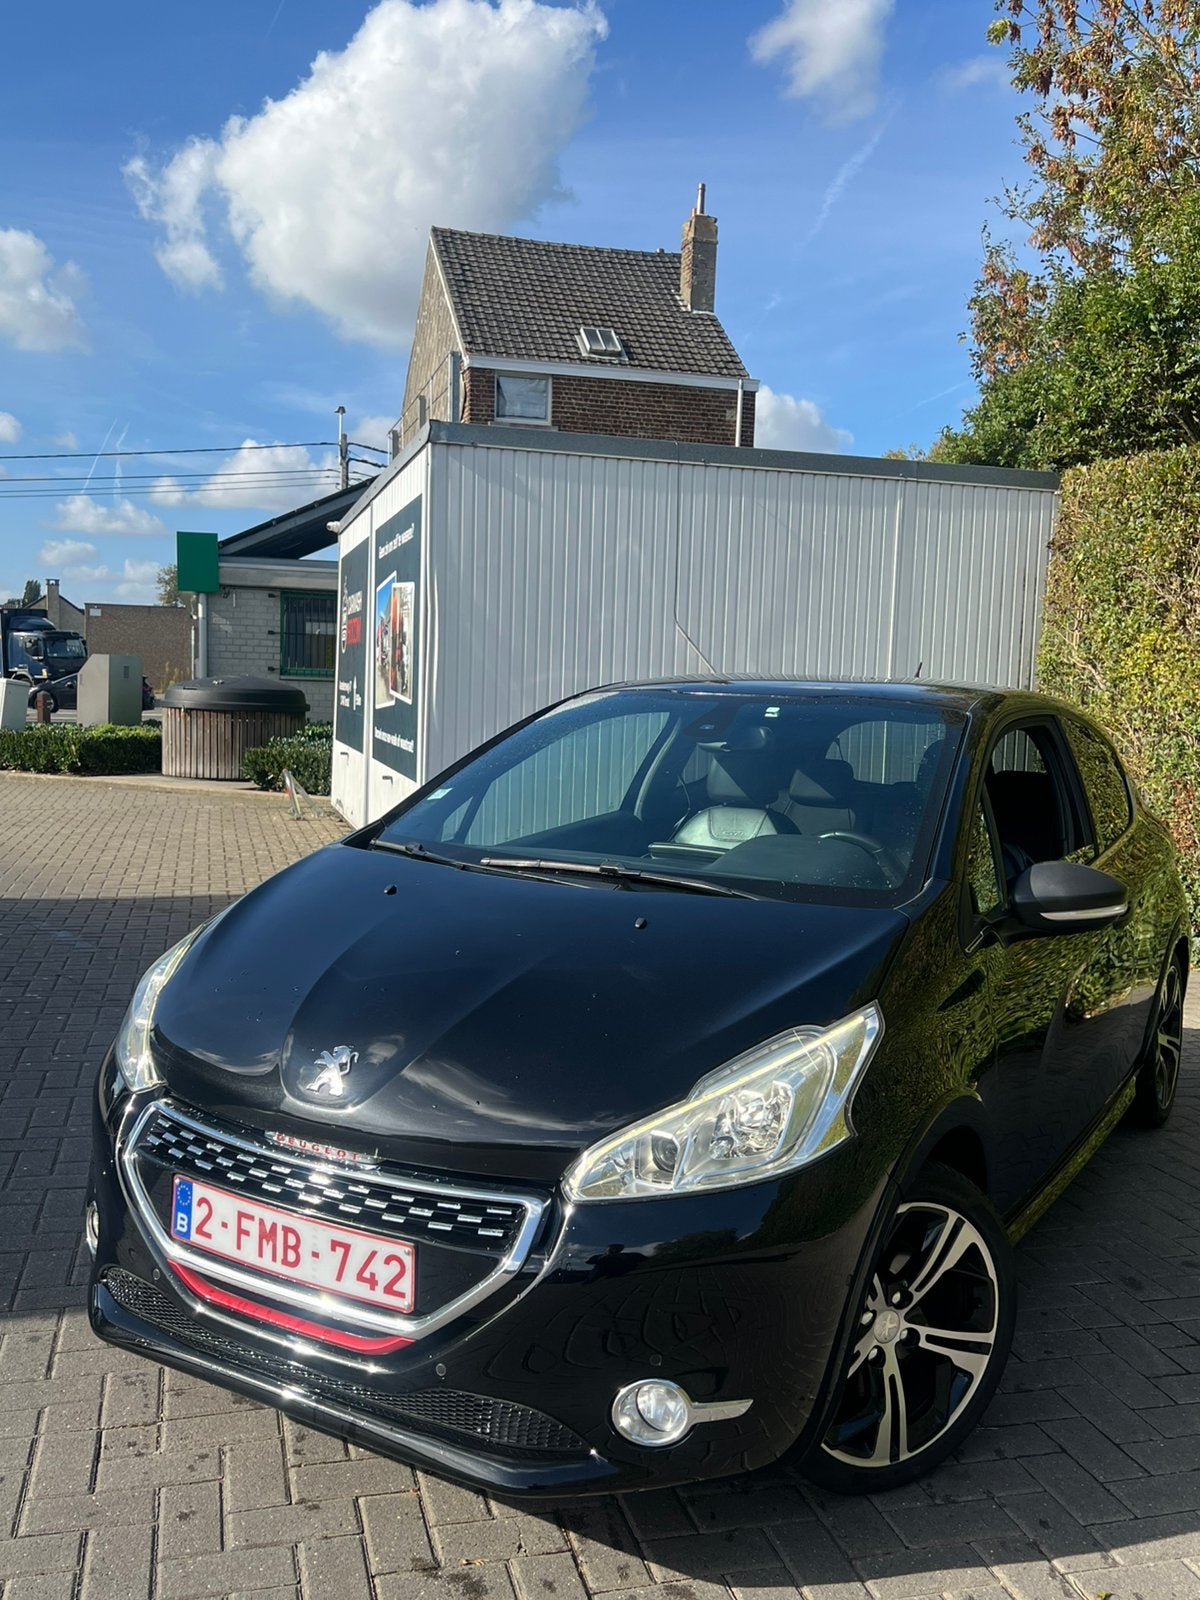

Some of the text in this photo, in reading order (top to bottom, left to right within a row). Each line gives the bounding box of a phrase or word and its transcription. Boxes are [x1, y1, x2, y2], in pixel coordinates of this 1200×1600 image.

[275, 1132, 361, 1161] PEUGEOT
[176, 1211, 188, 1233] B
[194, 1196, 407, 1299] 2-FMB-742
